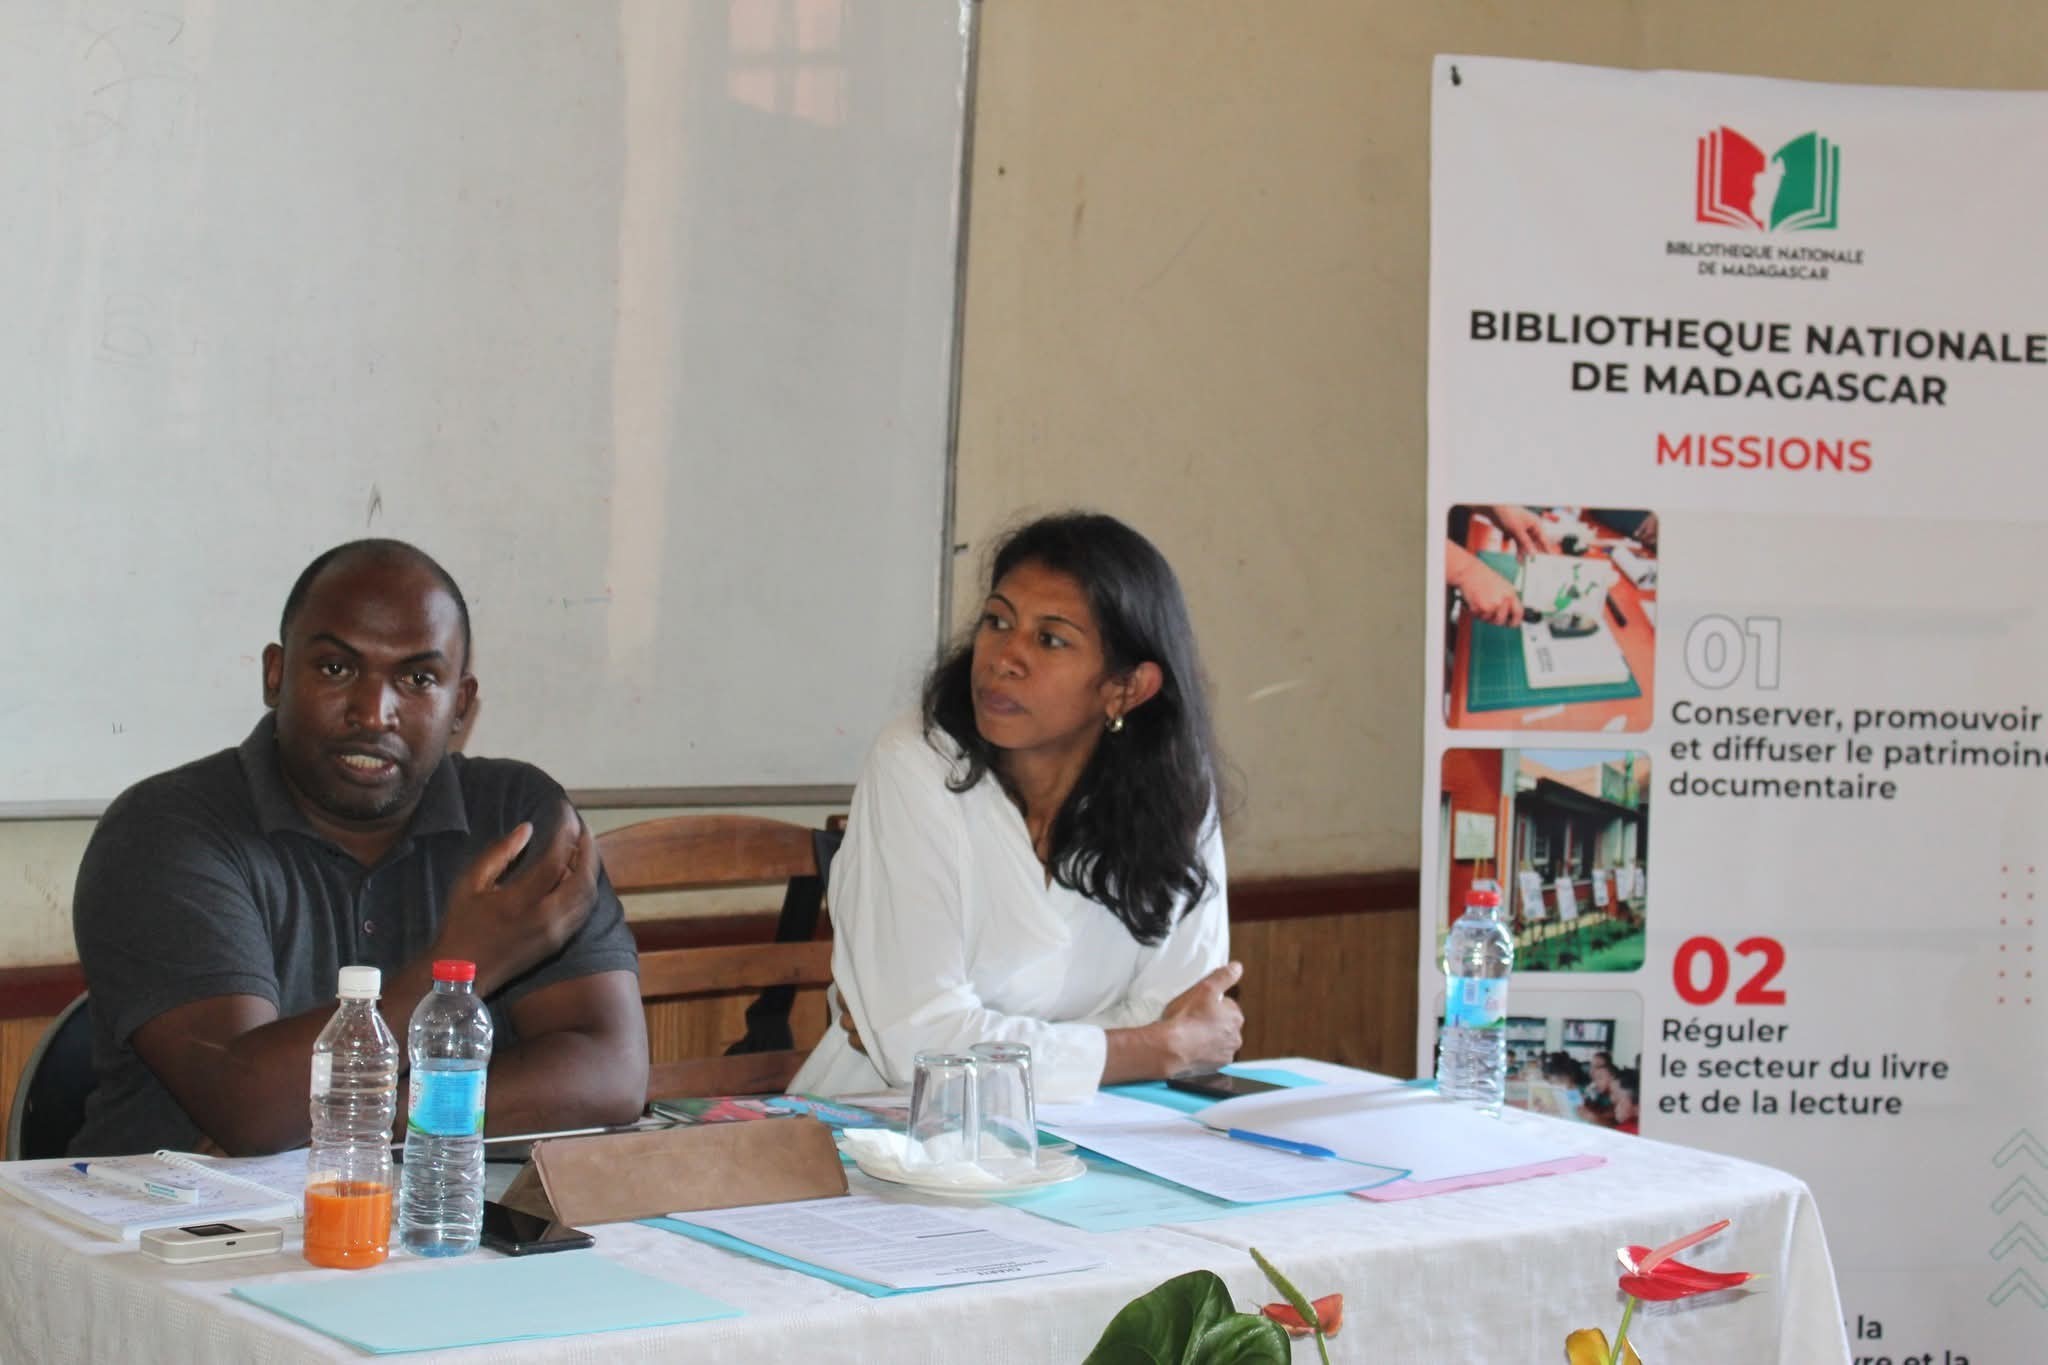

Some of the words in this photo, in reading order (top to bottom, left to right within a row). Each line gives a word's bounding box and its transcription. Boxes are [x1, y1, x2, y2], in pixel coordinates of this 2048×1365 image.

[1665, 241, 1773, 260] BIBLIOTHEQUE
[1777, 247, 1864, 265] NATIONALE
[1698, 261, 1717, 275] DE
[1721, 263, 1829, 281] MADAGASCAR
[1470, 310, 1791, 356] BIBLIOTHEQUE
[1806, 325, 2048, 364] NATIONALE
[1571, 362, 1629, 393] DE
[1644, 365, 1947, 405] MADAGASCAR
[1656, 433, 1873, 473] MISSIONS
[1684, 614, 1782, 690] 01
[1671, 701, 1843, 732] Conserver,
[1853, 705, 2042, 734] promouvoir
[1670, 739, 1701, 761] et
[1713, 737, 1837, 763] diffuser
[1847, 739, 1873, 764] le
[1885, 739, 2048, 769] patrimoin
[1669, 769, 1897, 799] documentaire
[1672, 936, 1787, 1006] 02
[1662, 1018, 1788, 1048] Réguler
[1660, 1053, 1688, 1079] le
[1698, 1056, 1820, 1079] secteur
[1830, 1054, 1871, 1080] du
[1882, 1054, 1950, 1080] livre
[1659, 1091, 1691, 1115] et
[1701, 1089, 1741, 1115] de
[1753, 1090, 1779, 1115] la
[1791, 1090, 1903, 1116] lecture
[1857, 1314, 1883, 1339] la
